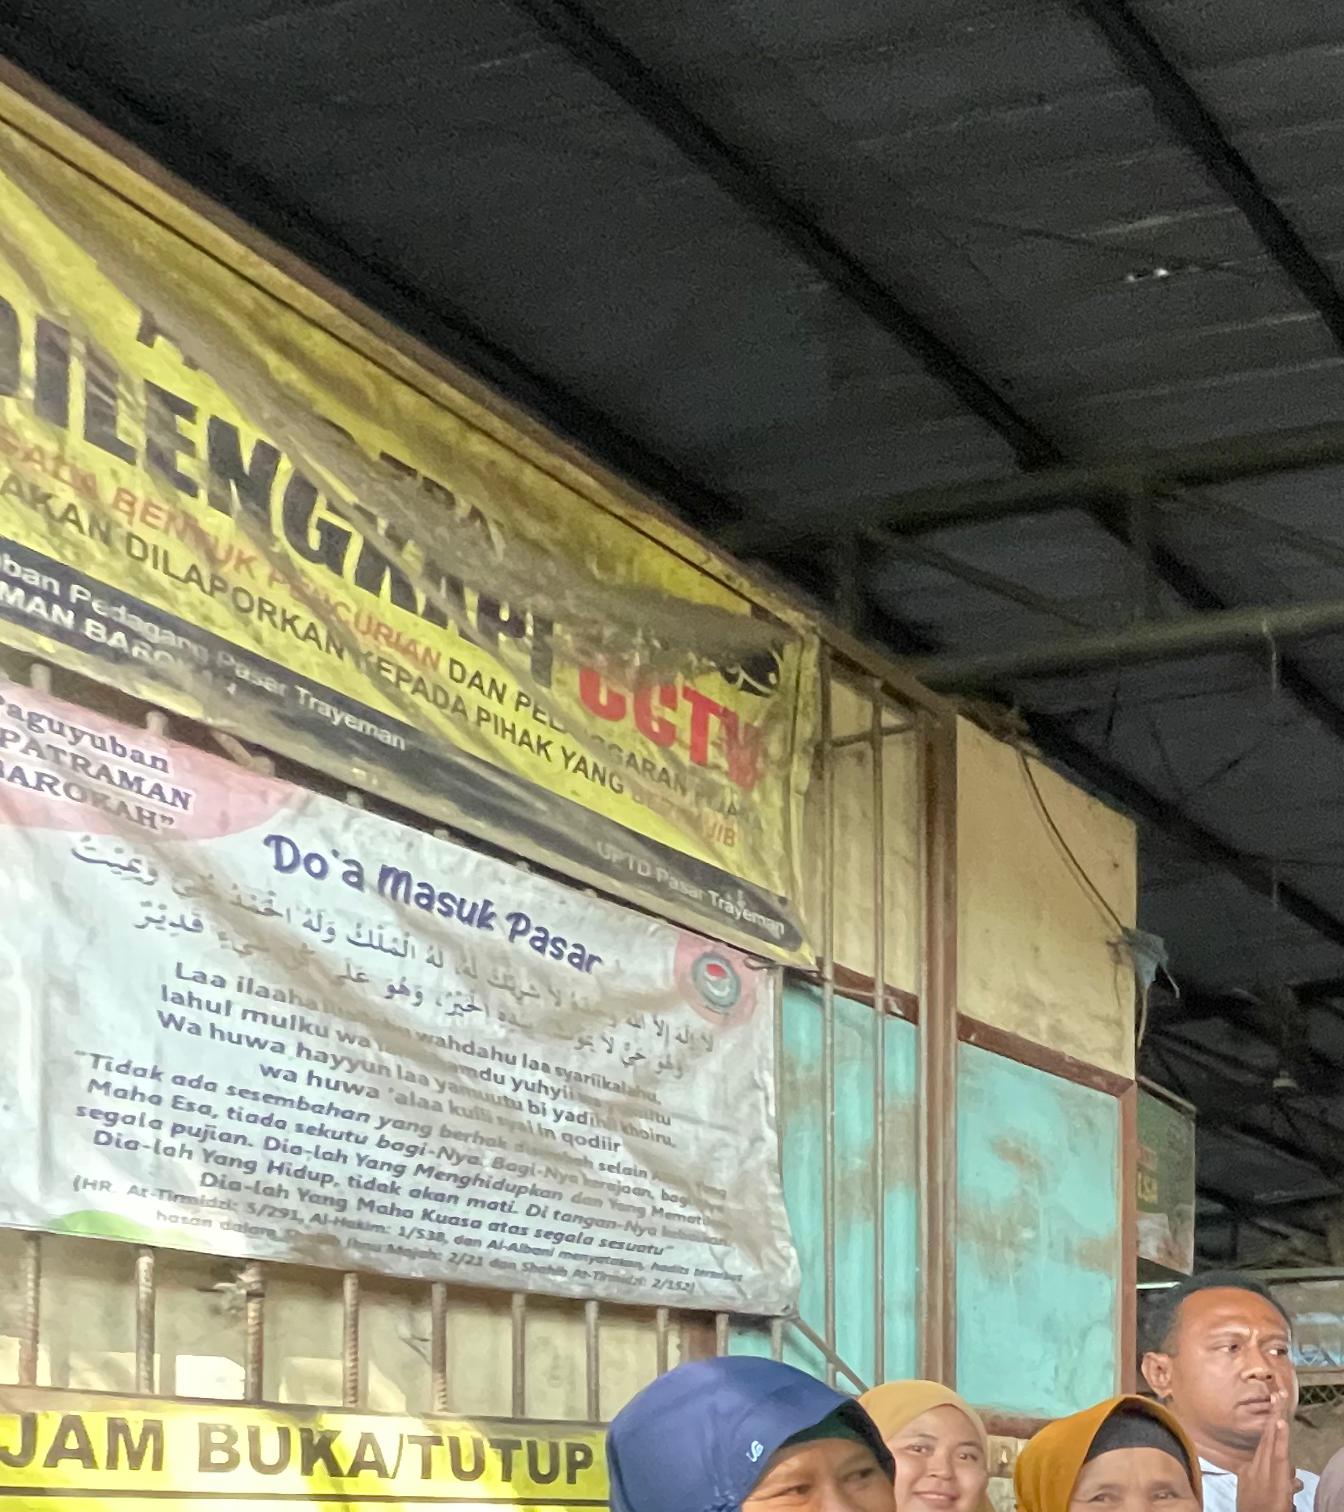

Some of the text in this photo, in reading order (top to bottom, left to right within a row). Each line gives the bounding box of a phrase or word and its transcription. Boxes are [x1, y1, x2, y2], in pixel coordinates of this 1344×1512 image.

[126, 531, 345, 661] DILAPORKAN
[359, 650, 469, 721] KEPADA
[476, 706, 555, 764] PIHAK
[560, 745, 625, 795] YANG
[449, 656, 507, 705] DAN
[0, 695, 170, 774] aguyuban
[294, 684, 406, 751] Trayeman
[0, 759, 176, 830] AROKAH”
[378, 863, 498, 932] Masuk
[505, 911, 604, 975] Pasar
[708, 889, 785, 938] Trayeman
[161, 984, 232, 1017] lahul
[241, 1006, 330, 1039] mulku
[336, 1029, 371, 1048] wa
[174, 961, 227, 989] Laa
[522, 1052, 552, 1075] laa
[156, 1010, 202, 1037] Wa
[209, 1022, 286, 1055] huwa
[296, 1041, 392, 1078] hayyun
[396, 1064, 430, 1086] laa
[528, 1100, 547, 1117] bi
[87, 1078, 163, 1107] Maha
[171, 1094, 218, 1119] Esa,
[226, 1104, 288, 1130] tiada
[294, 1121, 369, 1146] sekutu
[170, 1073, 218, 1094] ada
[225, 1083, 371, 1124] sesembahan
[374, 1114, 433, 1139] yang
[598, 1161, 648, 1179] selain
[259, 1063, 622, 1153] wa huwa qodiir
[75, 1104, 163, 1131] segala
[170, 1121, 254, 1149] pujian.
[263, 1134, 348, 1165] Dia-lah
[355, 1152, 407, 1178] Yang
[413, 1163, 563, 1201] Menghidupkan
[571, 1191, 604, 1208] dan
[608, 1197, 646, 1218] Yang
[93, 1130, 193, 1160] Dia-lah
[201, 1148, 258, 1175] Yang
[347, 1174, 402, 1196] tidak
[408, 1186, 459, 1205] akan
[466, 1196, 519, 1214] mati.
[525, 1203, 547, 1220] Di
[552, 1208, 657, 1237] tangan-Nya
[201, 1172, 290, 1199] Dia-lah
[297, 1185, 348, 1211] Yang
[356, 1196, 414, 1220] Maha
[421, 1207, 483, 1230] Kuasa
[487, 1221, 530, 1237] atas
[534, 1229, 594, 1246] segala
[454, 1235, 483, 1247] dan
[488, 1257, 518, 1271] dan
[0, 1412, 595, 1485] JAM BUKA/TUTUP
